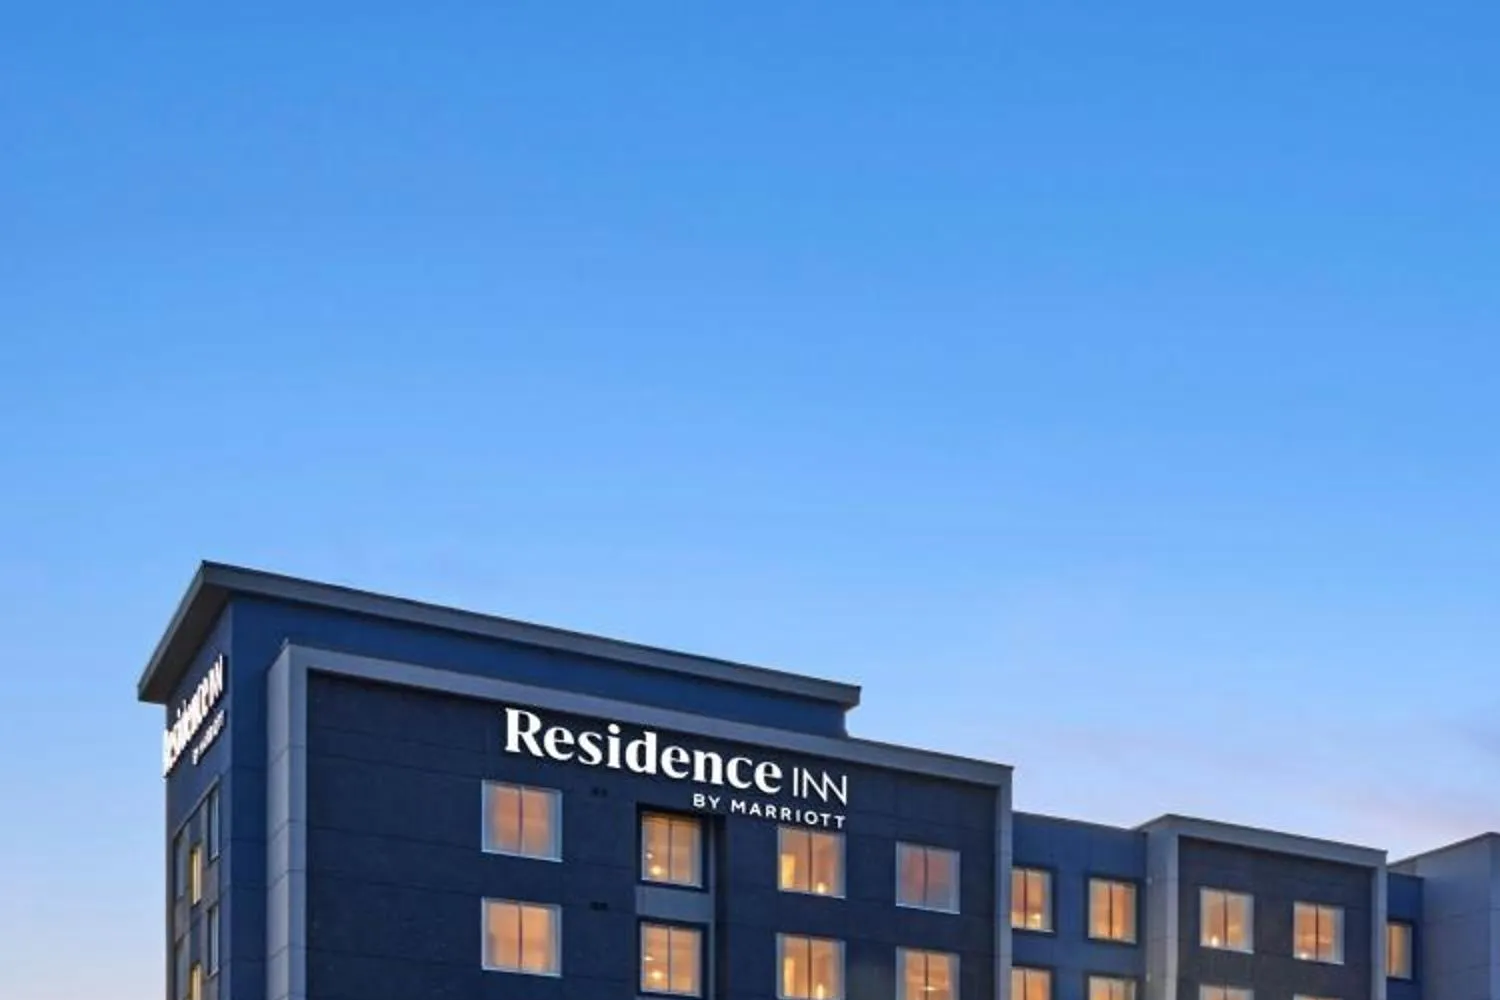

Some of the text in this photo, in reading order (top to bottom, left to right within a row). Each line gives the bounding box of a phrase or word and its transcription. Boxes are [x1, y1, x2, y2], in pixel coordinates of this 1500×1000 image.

[504, 707, 847, 806] Residence INN
[692, 793, 846, 829] BY MARRIOTT
